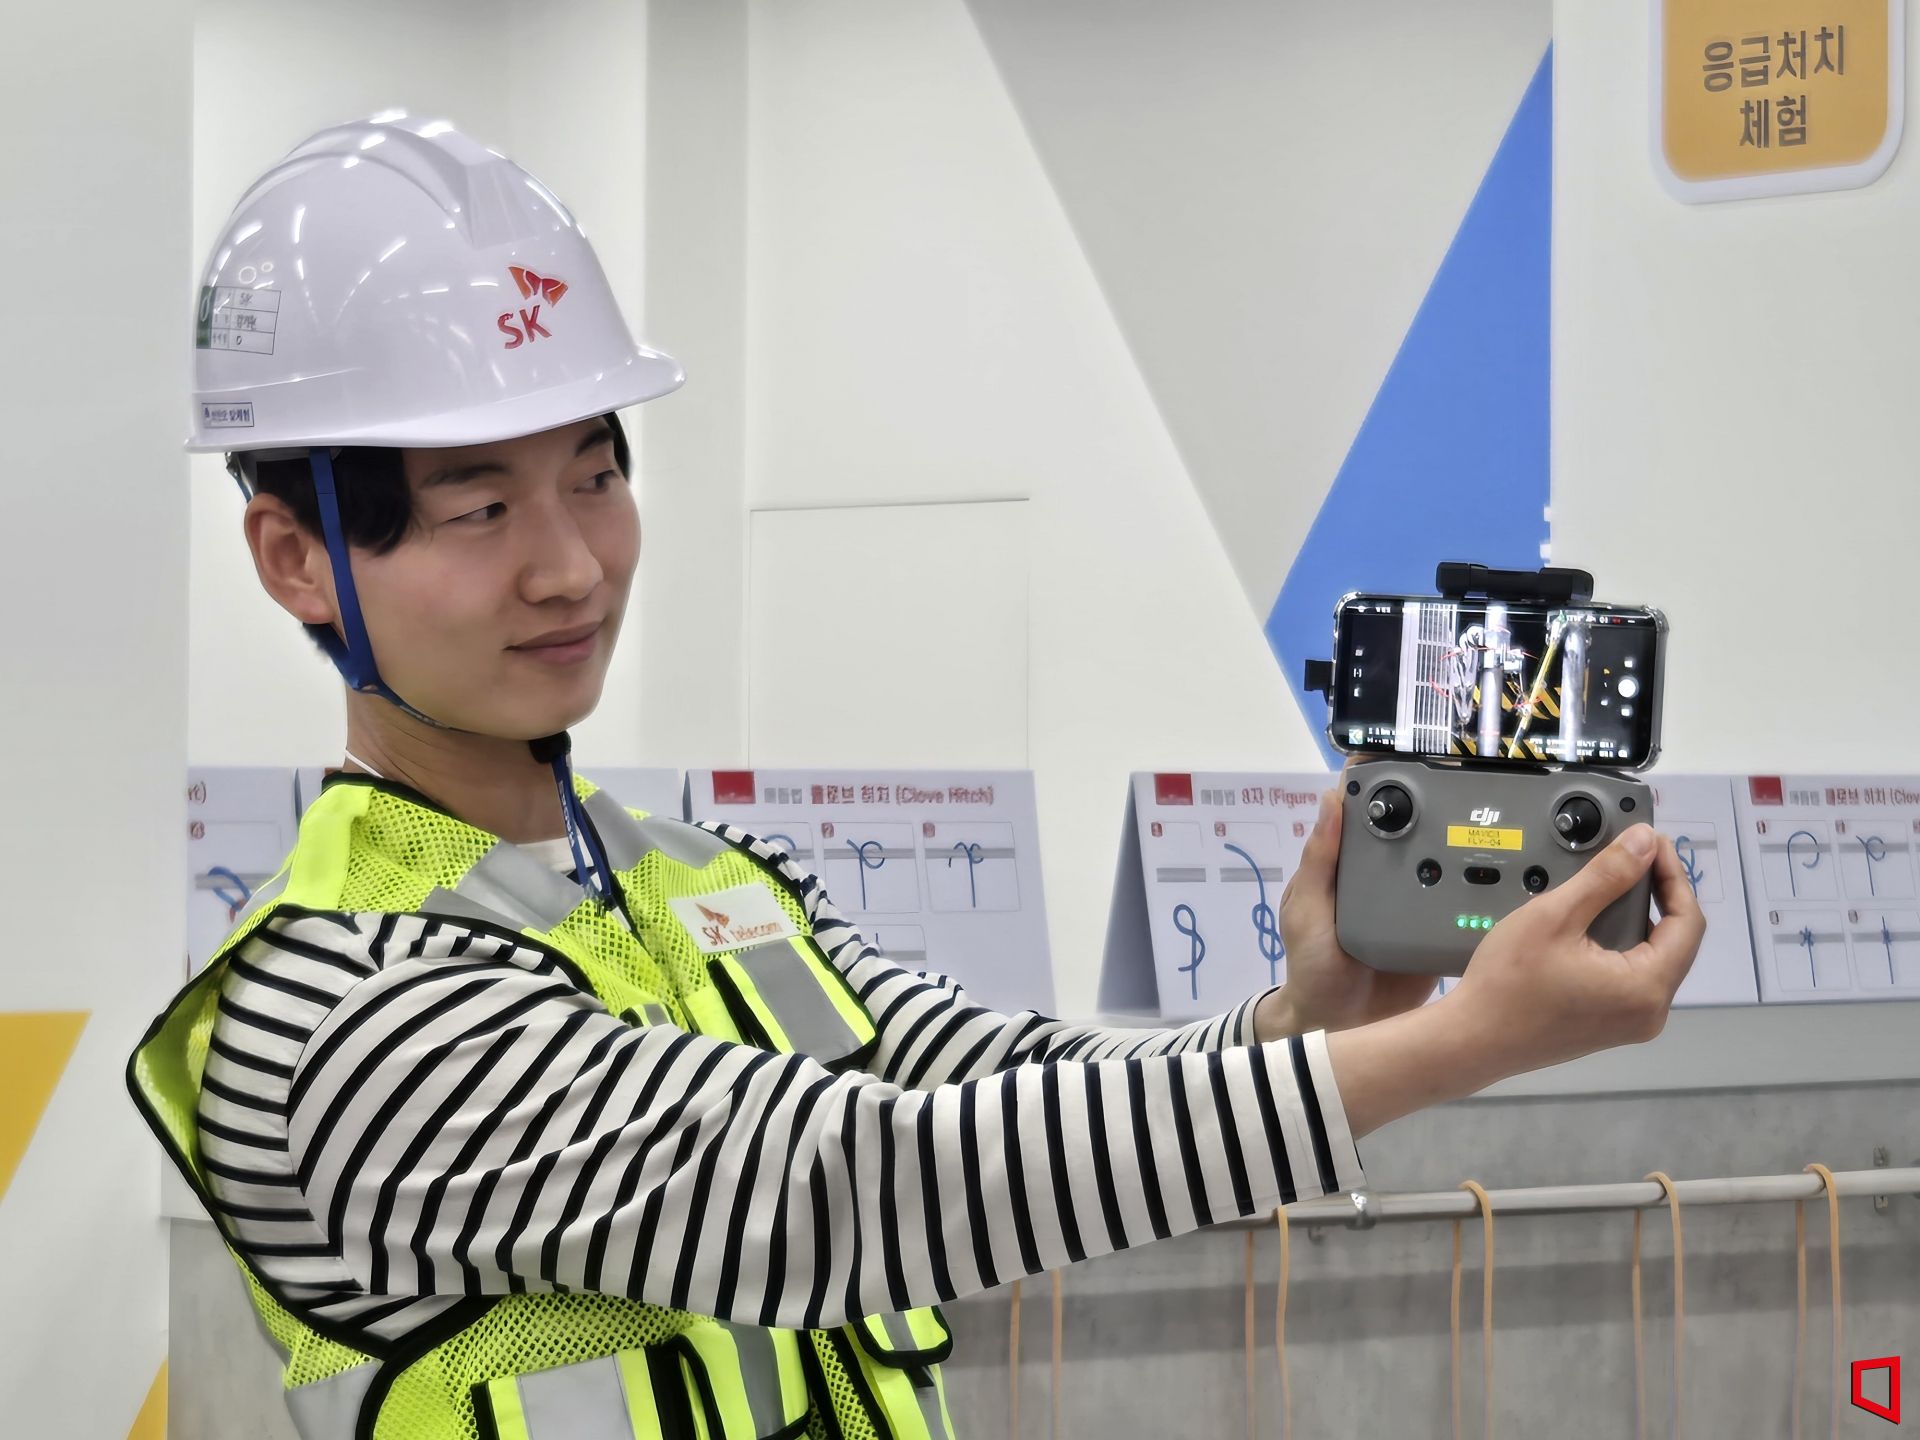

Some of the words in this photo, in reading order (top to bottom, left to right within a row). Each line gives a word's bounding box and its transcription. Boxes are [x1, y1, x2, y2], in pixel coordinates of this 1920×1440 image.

[1702, 25, 1845, 92] 응급처치
[1739, 95, 1808, 149] 체험
[497, 304, 553, 350] SK
[1470, 807, 1501, 826] dji
[702, 925, 730, 946] SK
